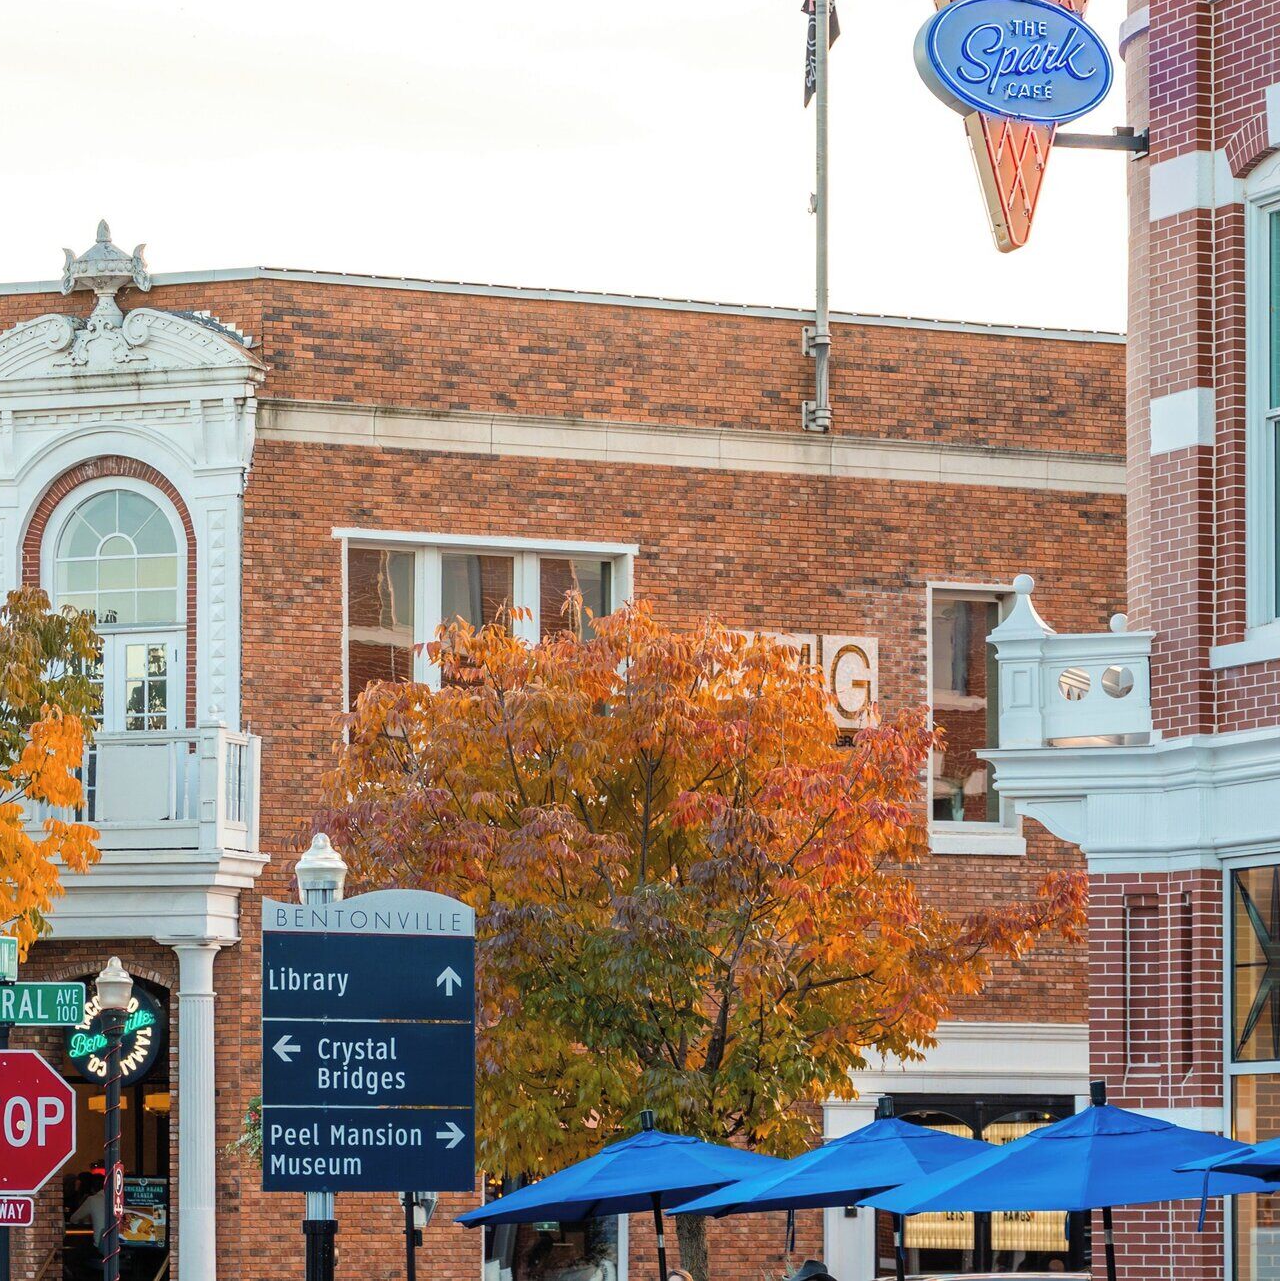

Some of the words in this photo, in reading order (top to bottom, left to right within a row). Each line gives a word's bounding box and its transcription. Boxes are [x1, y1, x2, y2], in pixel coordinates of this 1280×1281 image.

[1012, 19, 1048, 36] THE
[956, 23, 1098, 95] Spark
[276, 908, 462, 932] BENTONVILLE
[269, 967, 349, 997] Library
[56, 989, 79, 1005] AVE
[57, 1006, 78, 1022] 100
[318, 1037, 397, 1065] Crystal
[318, 1066, 406, 1095] Bridges
[271, 1123, 320, 1146] Peel
[330, 1122, 422, 1146] Mansion
[270, 1154, 362, 1176] Museum
